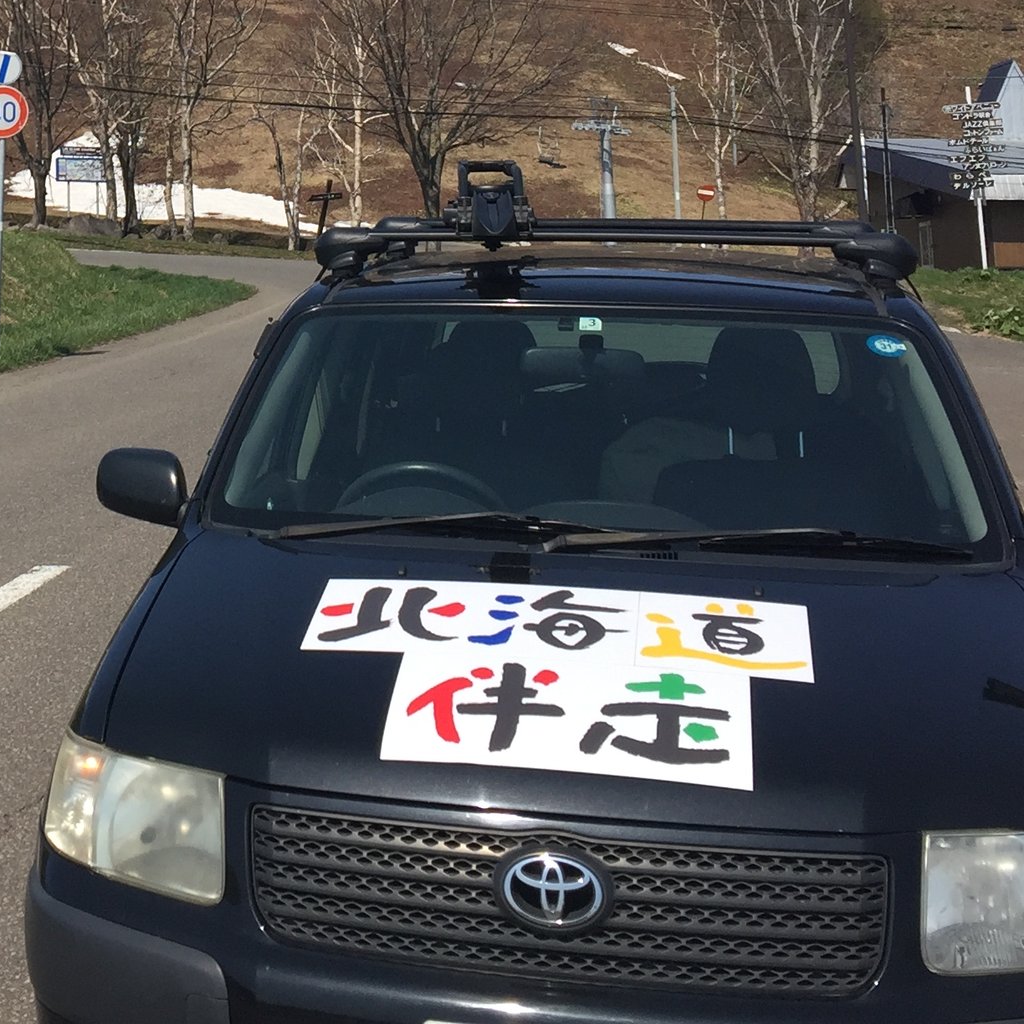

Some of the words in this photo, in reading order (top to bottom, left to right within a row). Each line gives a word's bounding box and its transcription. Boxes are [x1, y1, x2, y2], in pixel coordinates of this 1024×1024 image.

[588, 318, 596, 327] 3
[317, 586, 808, 671] 北海道
[406, 662, 732, 765] 伴走
